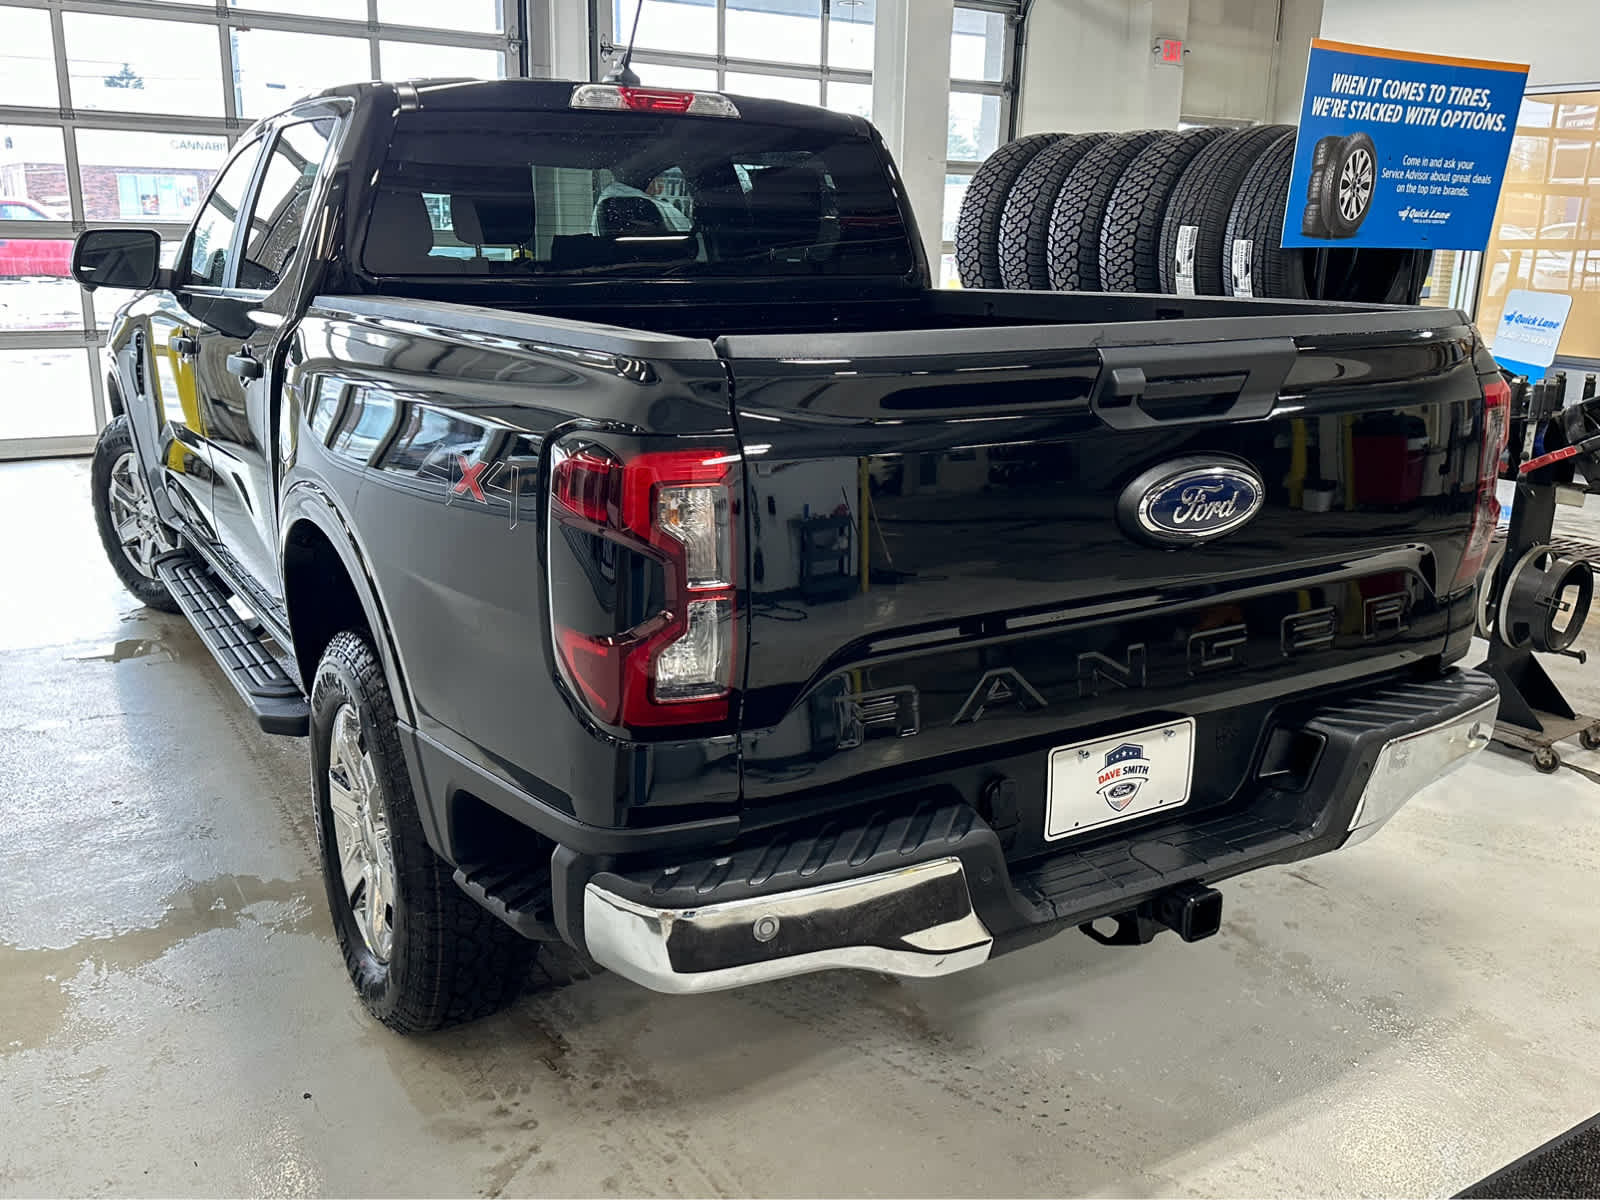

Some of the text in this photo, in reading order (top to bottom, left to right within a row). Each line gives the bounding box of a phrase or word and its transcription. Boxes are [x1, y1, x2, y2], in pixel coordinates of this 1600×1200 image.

[1331, 73, 1491, 111] WHEN IT COMES TO TIRES,
[1312, 96, 1507, 132] WE'RE STACKED WITH OPTIONS.
[1403, 155, 1475, 171] Come in and ask your
[1382, 168, 1492, 184] Service Advisor about great deals
[1396, 184, 1470, 197] on the top tire brands.
[1408, 208, 1451, 219] Quick Lane
[1514, 314, 1537, 325] Quick
[1537, 317, 1560, 329] Lane
[1173, 484, 1239, 524] Ford
[837, 593, 1411, 749] RANGER
[1098, 765, 1149, 784] DAVE SMITH
